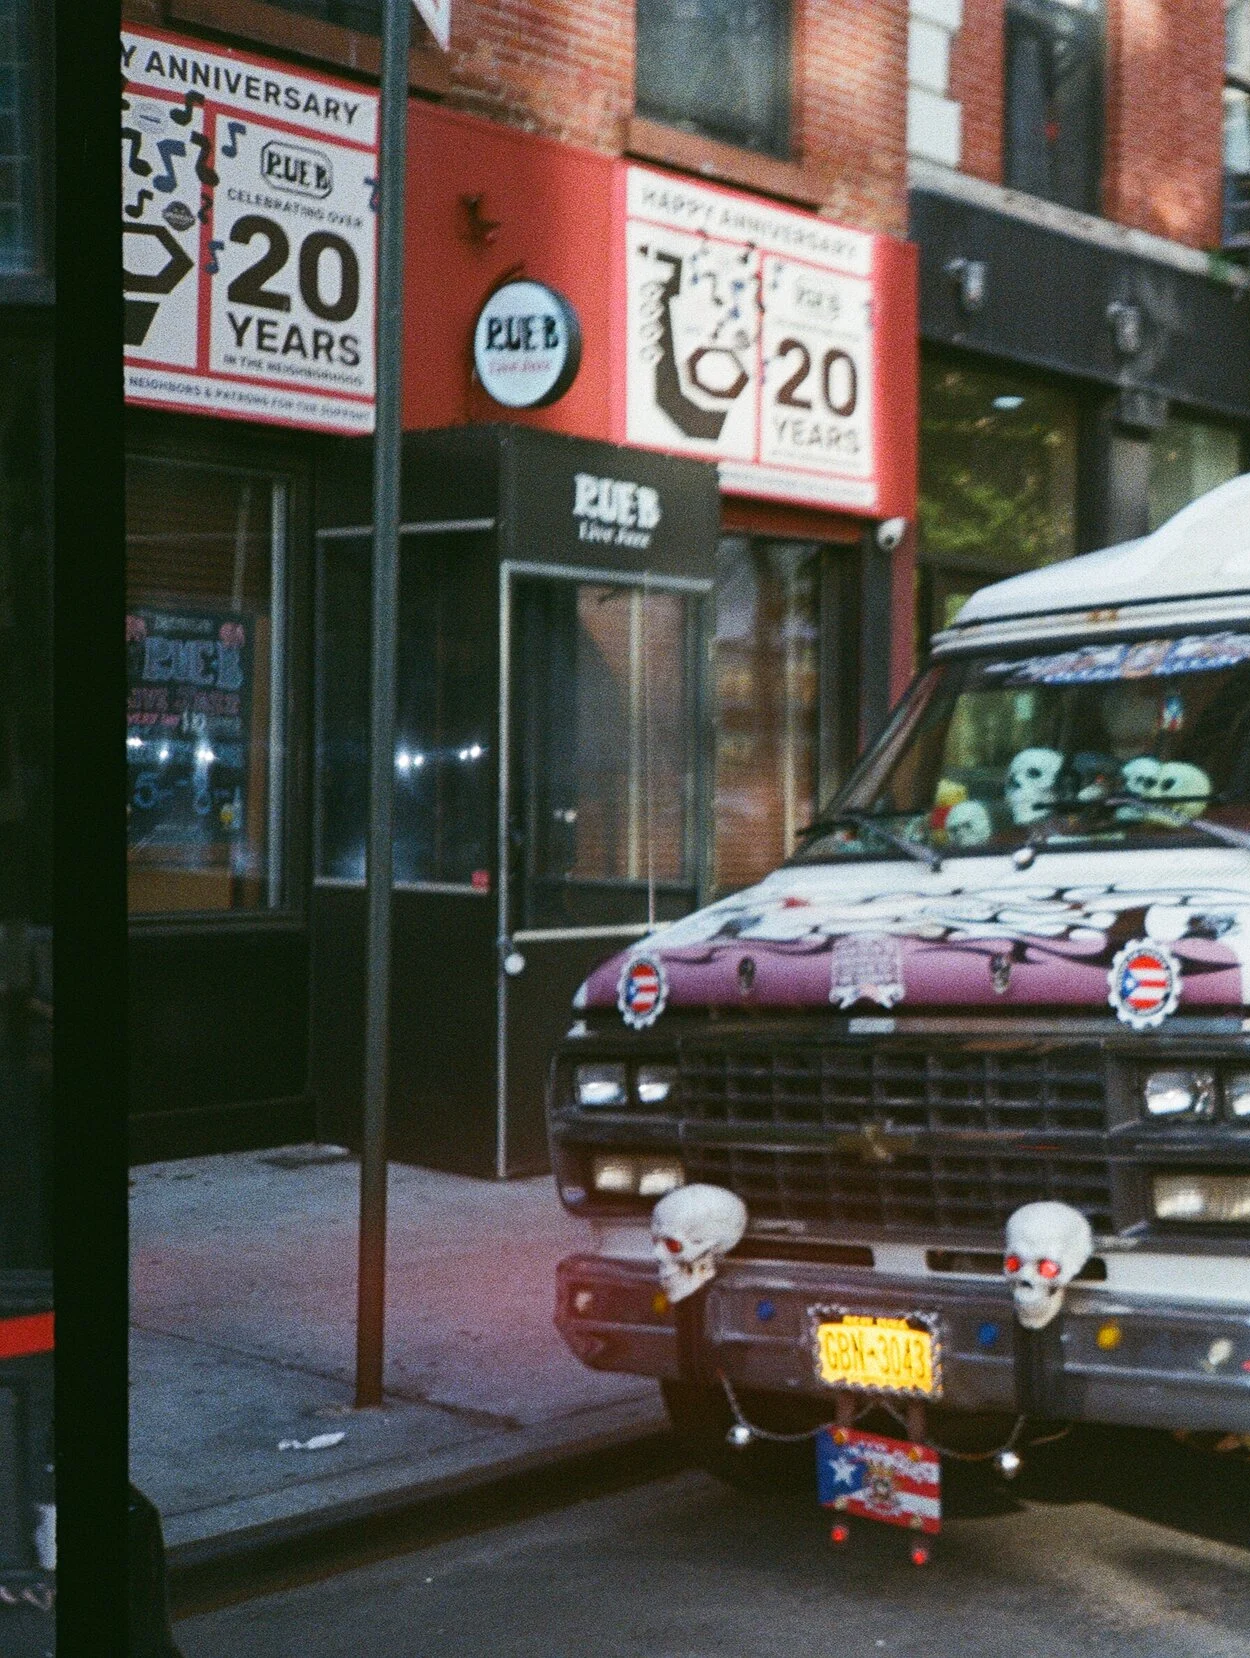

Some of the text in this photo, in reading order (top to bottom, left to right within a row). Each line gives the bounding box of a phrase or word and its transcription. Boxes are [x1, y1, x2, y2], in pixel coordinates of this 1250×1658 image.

[145, 50, 361, 126] ANNIVERSARY
[227, 188, 325, 220] CELEBRATING
[643, 187, 713, 218] HAPPY
[227, 214, 360, 322] 20
[226, 311, 361, 367] YEARS
[240, 356, 263, 369] THE
[776, 337, 858, 418] 20
[129, 376, 202, 396] NEIGHBORS
[215, 388, 268, 407] PATRONS
[271, 396, 293, 409] FOR
[774, 416, 861, 454] YEARS
[823, 1331, 926, 1380] GBN-3043
